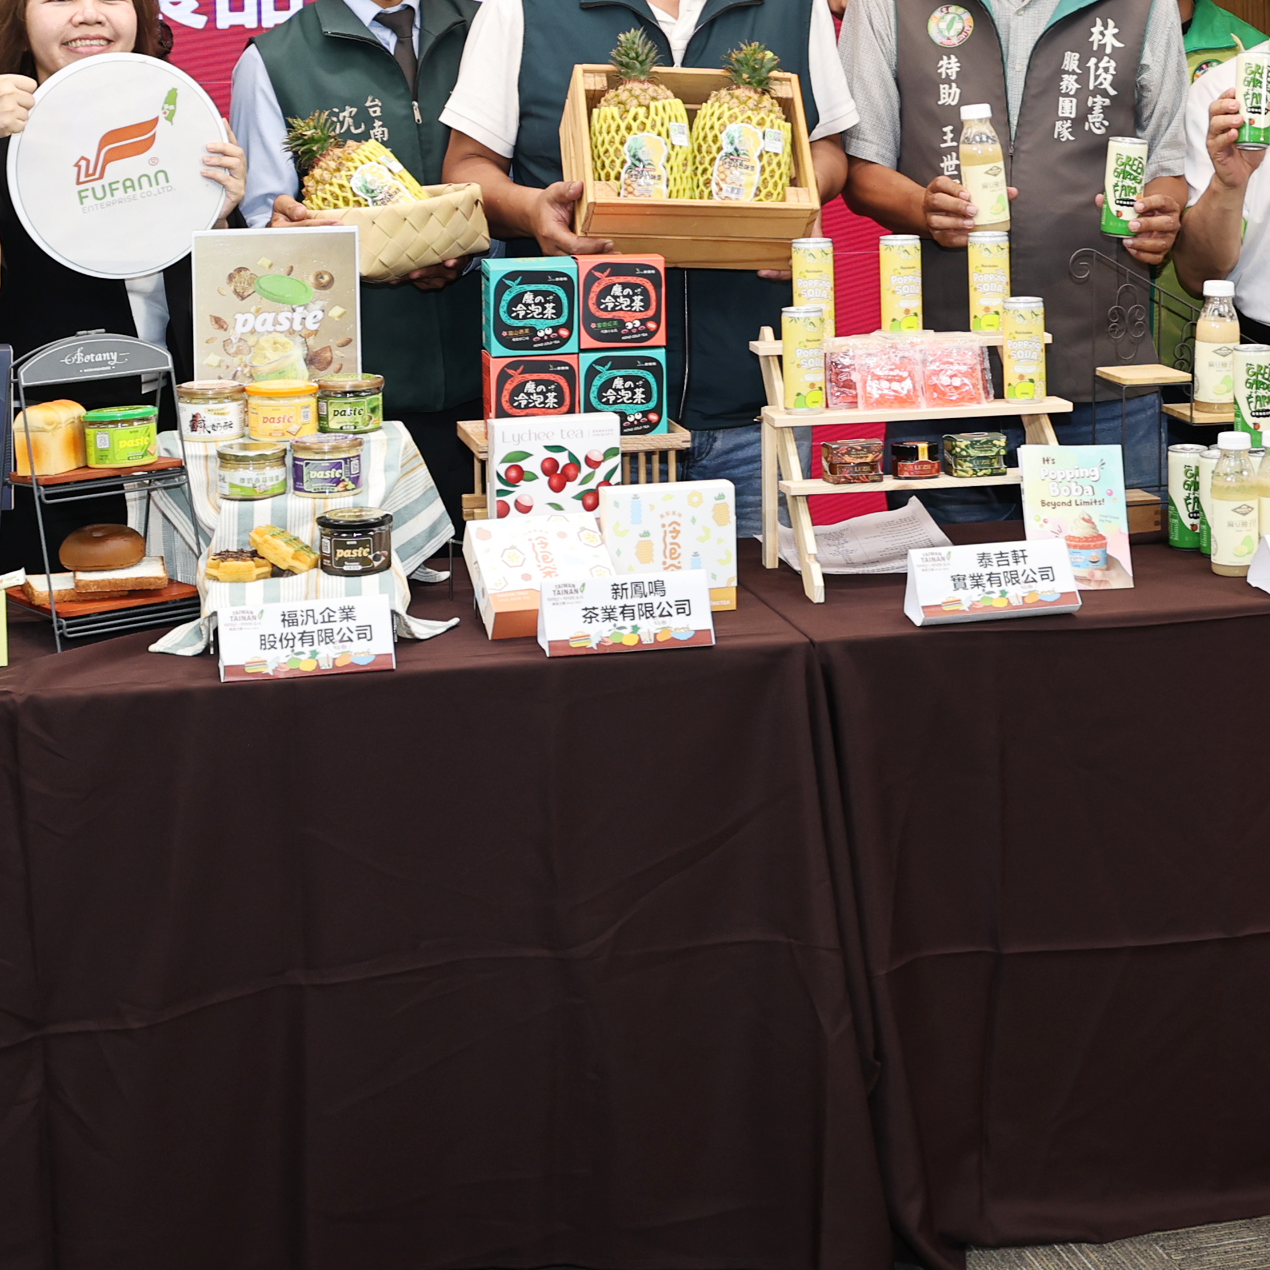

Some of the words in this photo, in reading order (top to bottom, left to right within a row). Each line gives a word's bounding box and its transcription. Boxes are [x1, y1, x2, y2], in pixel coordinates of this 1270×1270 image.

[937, 54, 962, 107] 特助
[1084, 17, 1126, 135] 林俊憲
[1053, 50, 1083, 142] 服務團隊
[331, 106, 365, 136] 沈
[365, 95, 389, 143] 台南
[939, 125, 962, 185] 王世
[77, 170, 169, 205] FUFANN
[81, 193, 138, 214] ENTERPRISE
[800, 288, 828, 299] SODA
[976, 283, 1004, 293] SODA
[511, 303, 557, 319] 冷泡茶
[600, 295, 645, 311] 冷泡茶
[234, 304, 325, 342] paste
[65, 347, 119, 366] Botany
[1010, 350, 1038, 360] SODA
[513, 392, 559, 409] 冷泡茶
[601, 388, 647, 404] 冷泡茶
[501, 428, 555, 446] Lychee
[560, 428, 585, 440] tea
[1042, 457, 1056, 465] It's
[1040, 465, 1101, 482] Popping
[1049, 481, 1095, 497] Boba
[1041, 499, 1072, 509] Beyond
[1075, 498, 1105, 506] Limits!
[976, 549, 1028, 569] 泰吉軒
[950, 566, 1056, 592] 實業有限公司
[610, 579, 667, 601] 新鳳鳴
[280, 605, 357, 629] 福汎企業
[581, 598, 692, 625] 茶業有限公司
[259, 624, 373, 651] 股份有限公司
